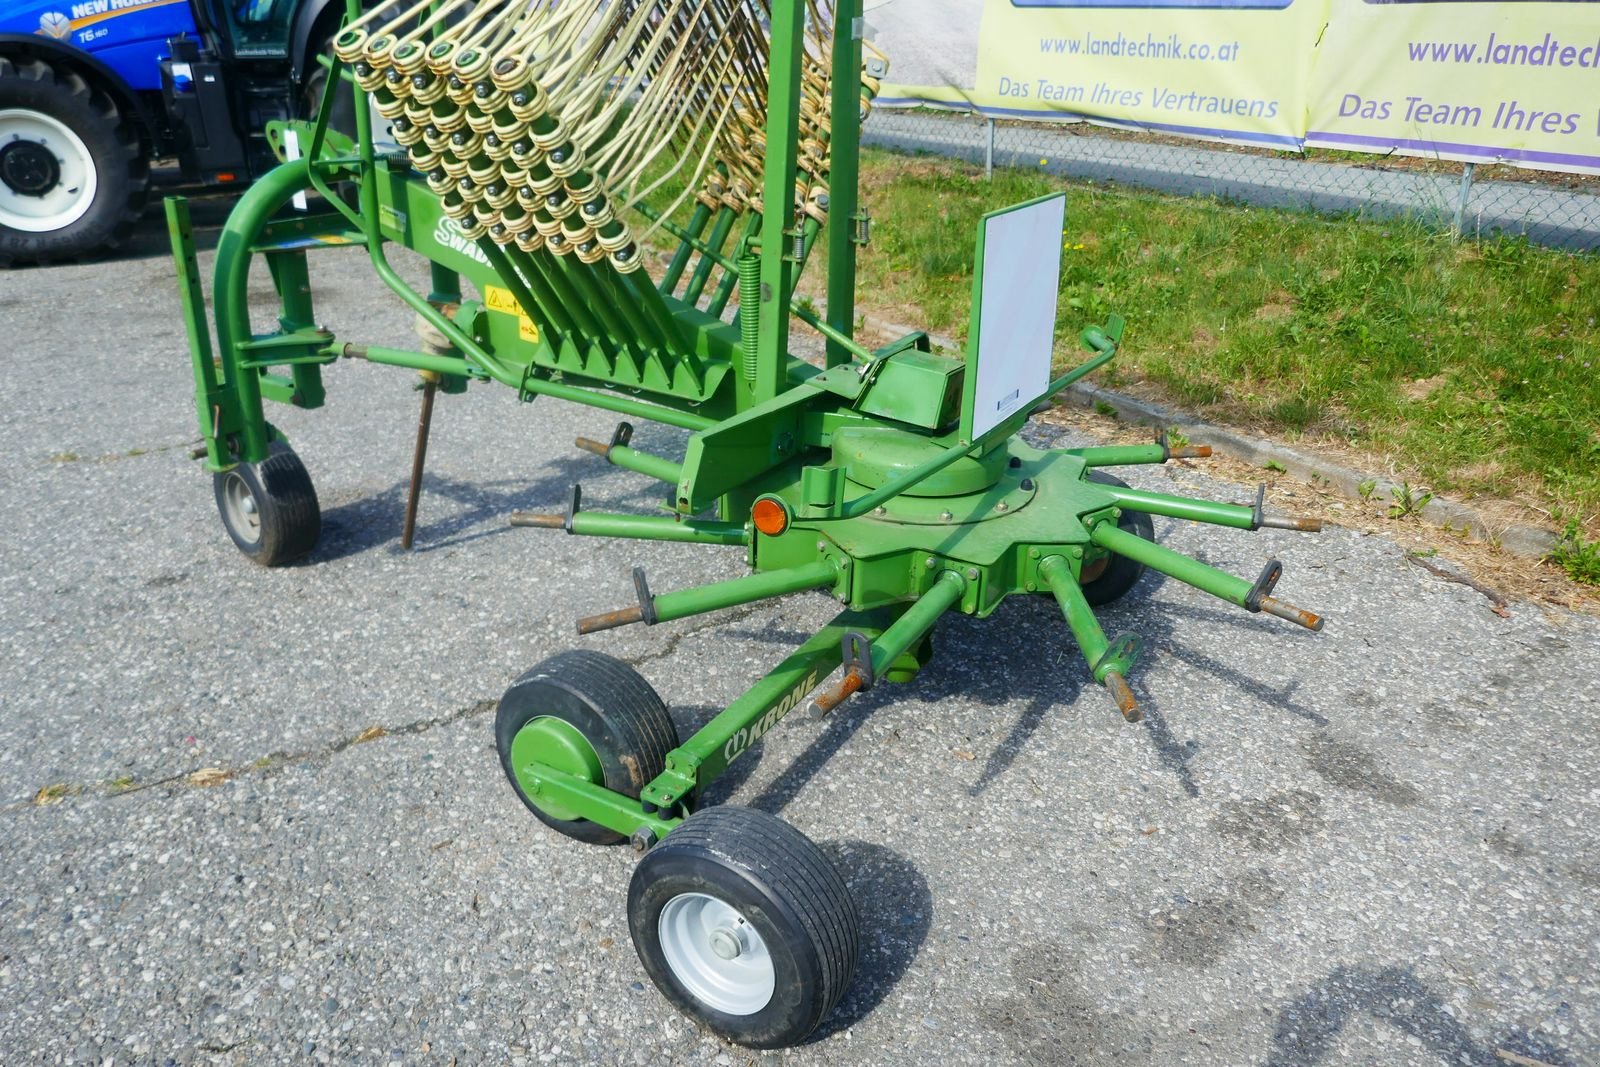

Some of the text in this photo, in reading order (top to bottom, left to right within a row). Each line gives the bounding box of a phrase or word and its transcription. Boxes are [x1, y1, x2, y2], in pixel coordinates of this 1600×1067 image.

[71, 0, 108, 19] NEW
[1040, 31, 1240, 61] www.landtechnik.co.at
[998, 77, 1279, 119] Das Team Ihres Vertrauens
[1338, 93, 1393, 120] Das
[1404, 96, 1482, 127] Team
[1492, 101, 1581, 135] Ihres
[748, 668, 818, 747] KRONE
